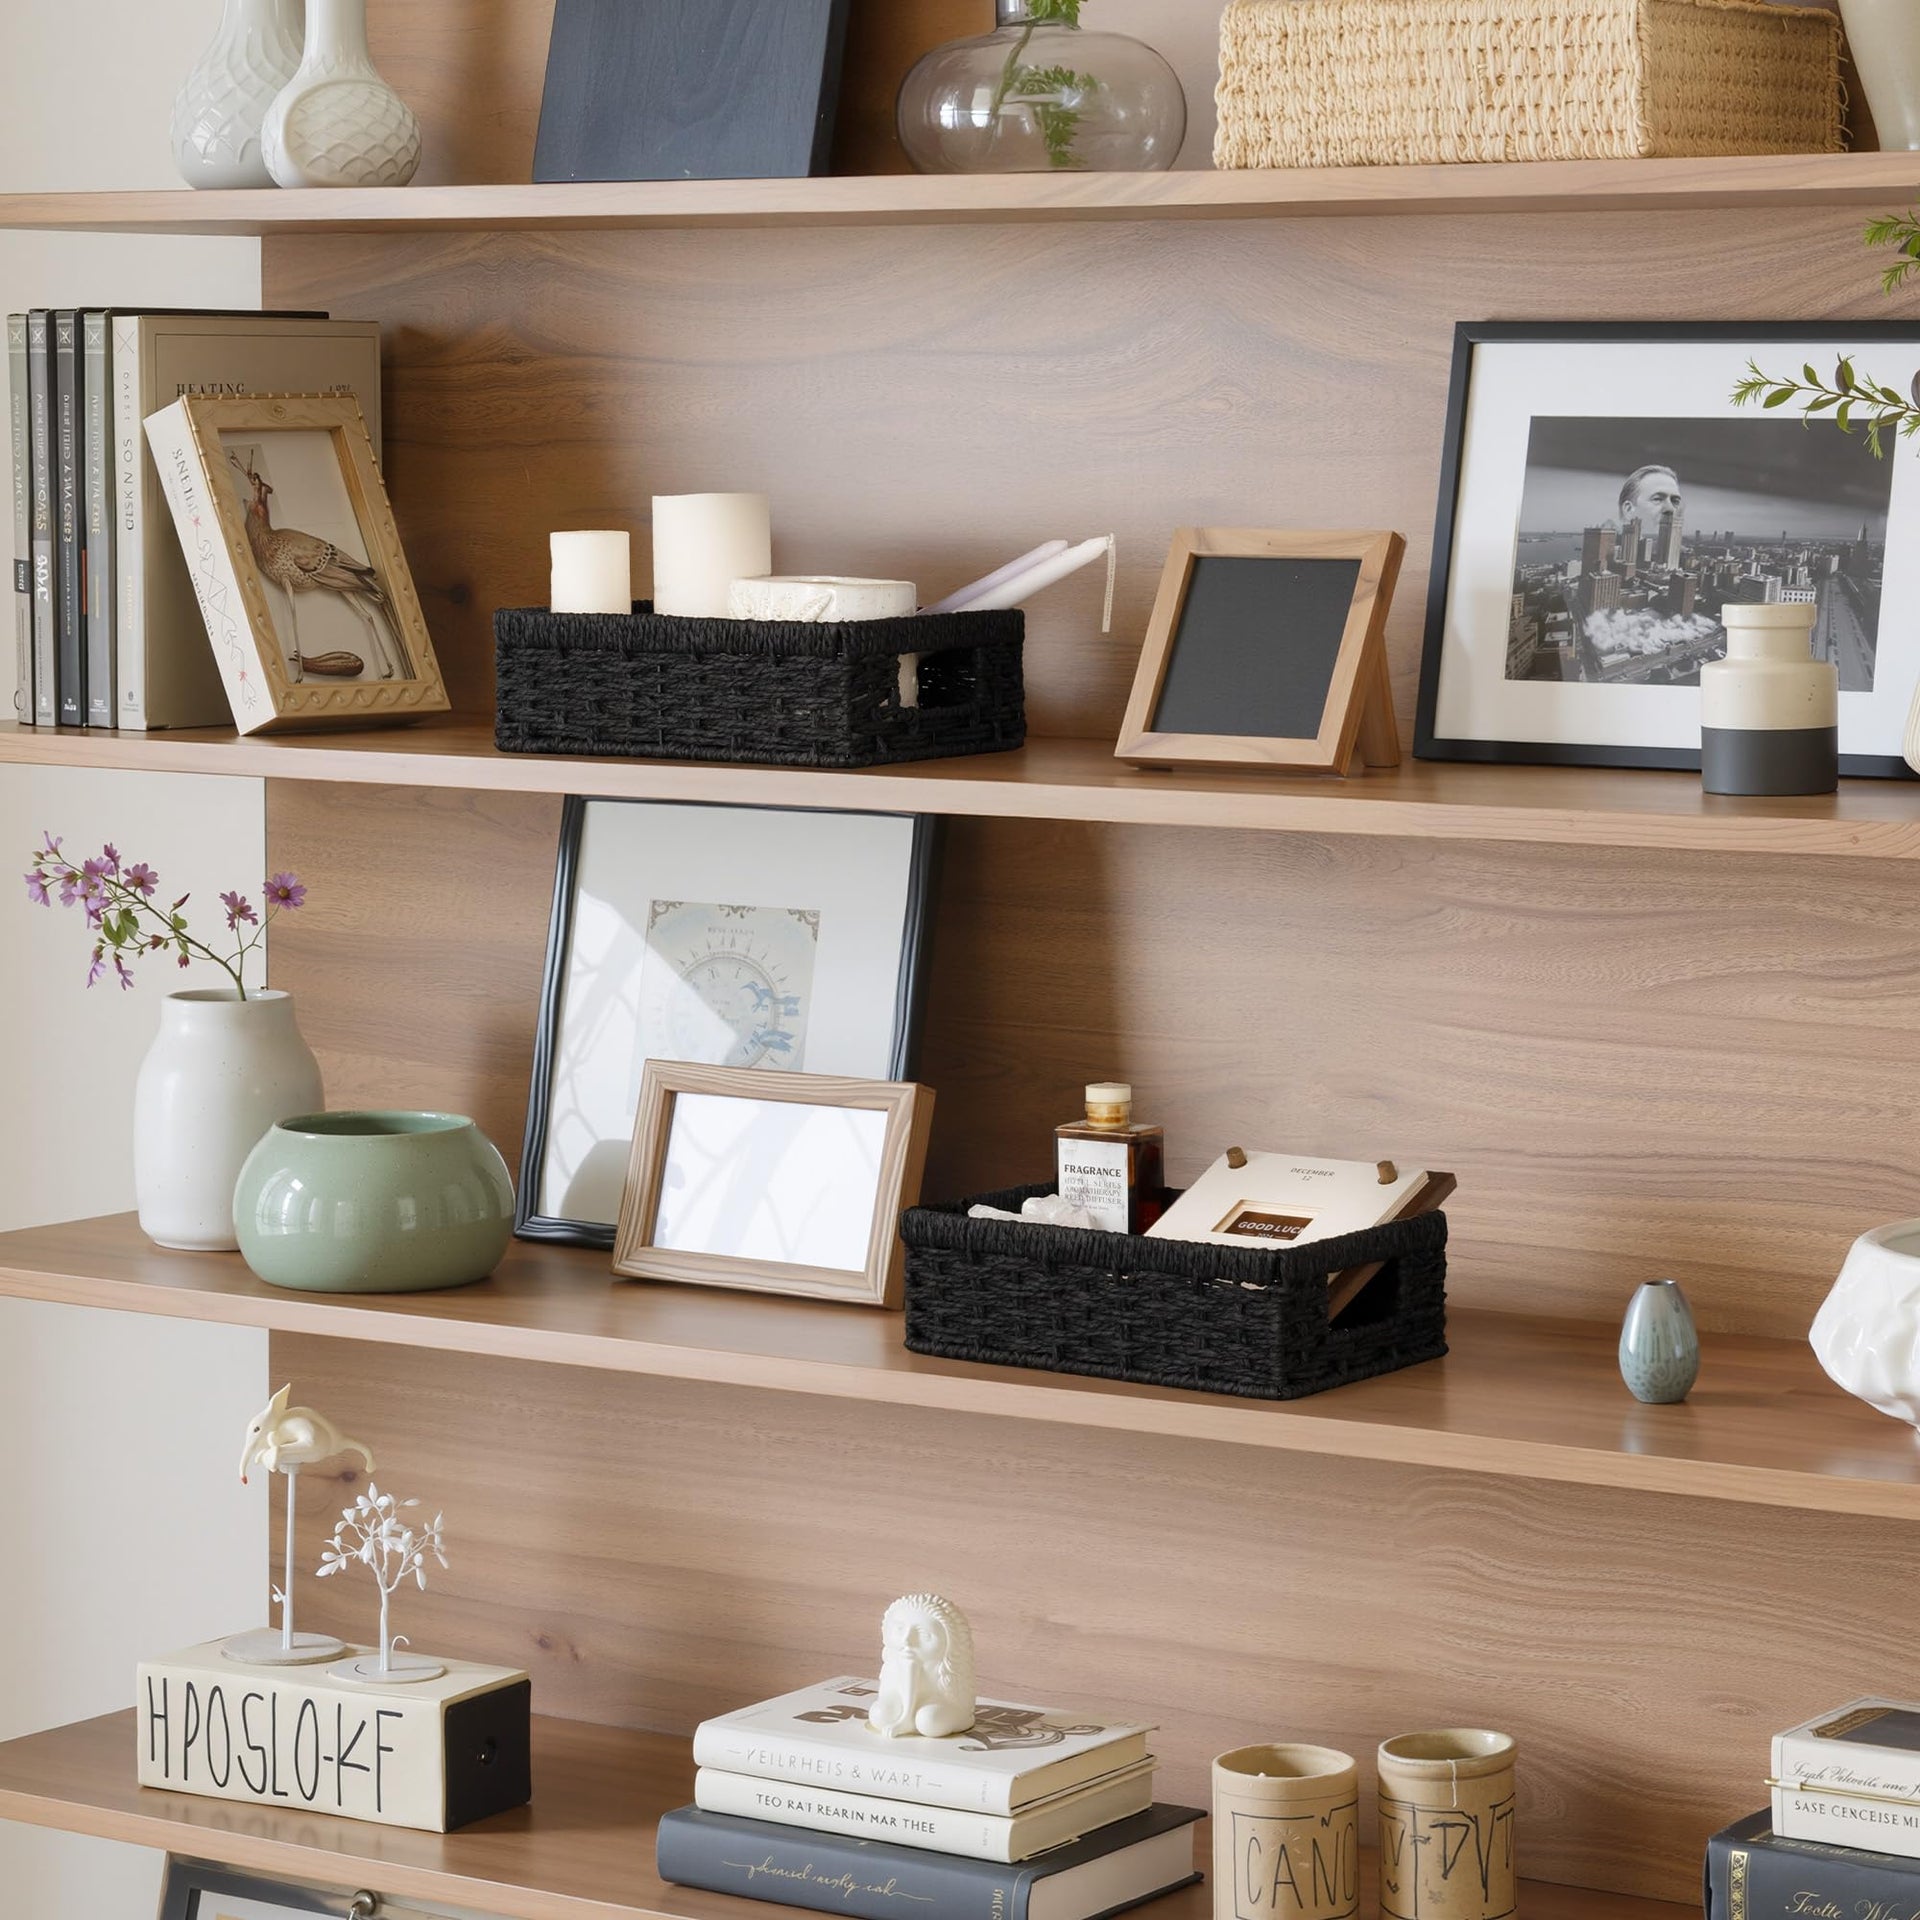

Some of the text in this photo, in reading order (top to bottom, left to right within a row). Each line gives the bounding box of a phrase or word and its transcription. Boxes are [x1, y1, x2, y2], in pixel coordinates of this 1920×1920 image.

[176, 383, 245, 396] HEATING
[1064, 1164, 1122, 1177] FRAGRANCE
[1290, 1167, 1336, 1177] DECEMBER
[1238, 1221, 1275, 1231] GOOD
[871, 1767, 924, 1788] WART
[756, 1793, 782, 1808] TEO
[817, 1804, 865, 1821] REARIN
[870, 1813, 898, 1827] MAR
[902, 1817, 936, 1834] THEE
[1794, 1799, 1826, 1815] SASE
